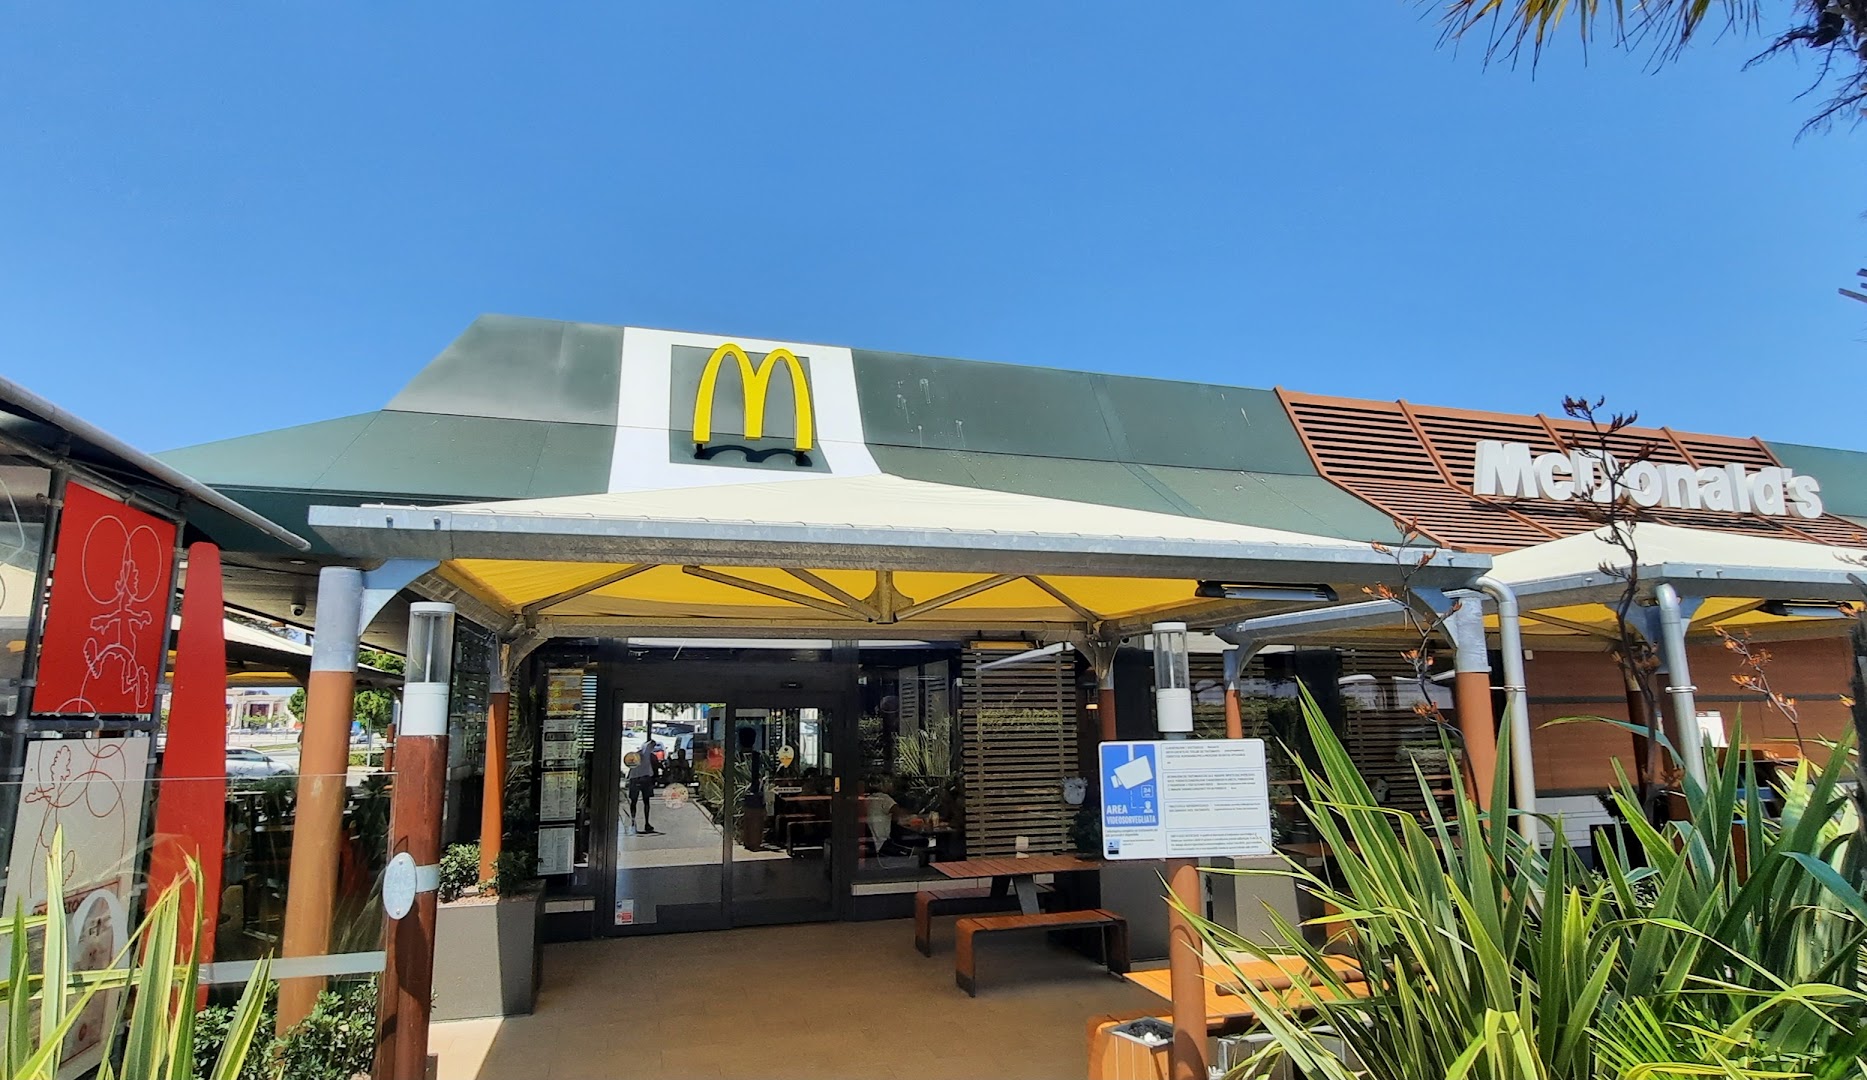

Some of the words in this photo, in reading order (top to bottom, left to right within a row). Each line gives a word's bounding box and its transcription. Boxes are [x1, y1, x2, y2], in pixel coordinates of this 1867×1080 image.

[1473, 439, 1823, 519] McDonald's
[1106, 804, 1128, 815] AREA
[1106, 814, 1157, 825] VIDEOSORVEGLIATA
